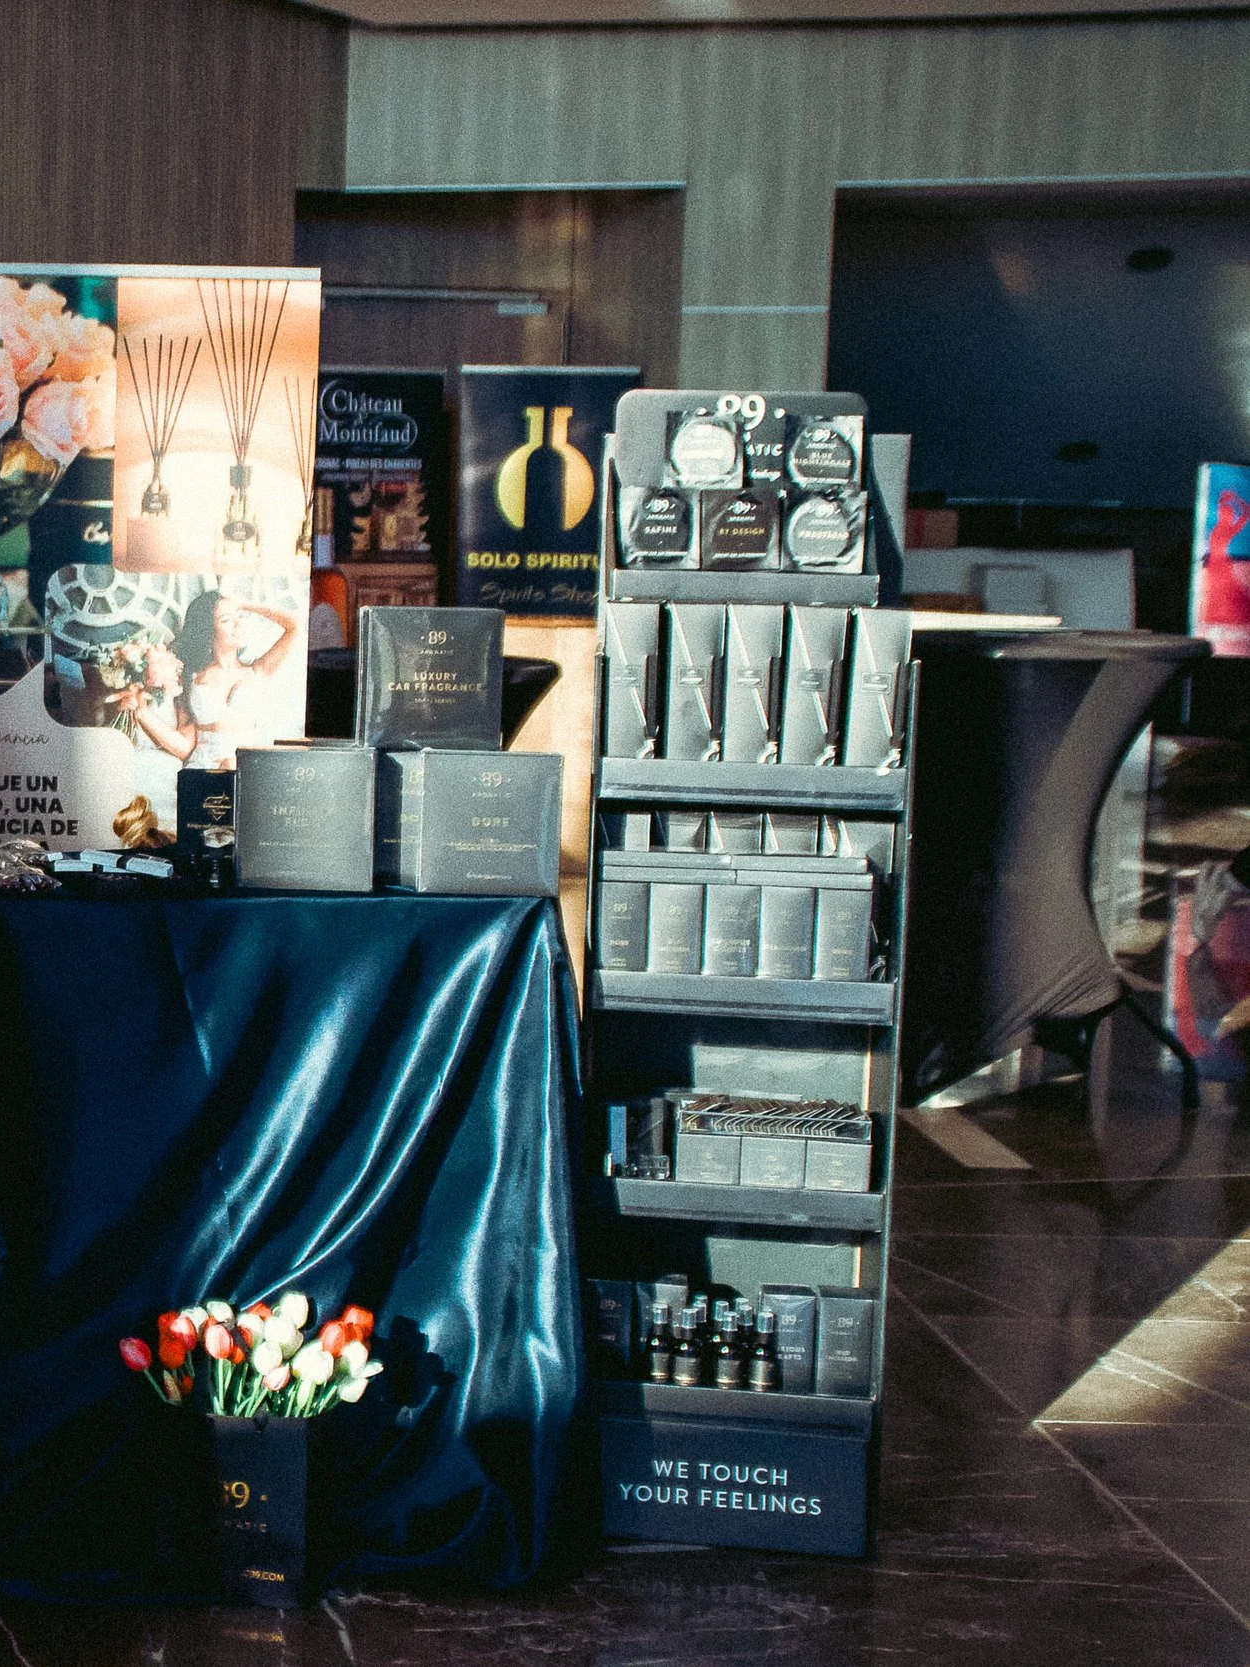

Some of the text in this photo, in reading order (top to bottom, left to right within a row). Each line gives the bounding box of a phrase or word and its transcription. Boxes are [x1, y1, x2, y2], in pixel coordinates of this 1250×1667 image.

[467, 552, 520, 569] SOLO
[428, 630, 447, 645] 89
[414, 671, 457, 681] LUXURY
[388, 682, 482, 692] CAR FRAGRANCE
[26, 774, 58, 792] UN
[15, 797, 65, 814] UNA
[51, 819, 78, 836] DE
[654, 1460, 788, 1486] WE TOUCH
[619, 1483, 822, 1516] YOUR FEELINGS
